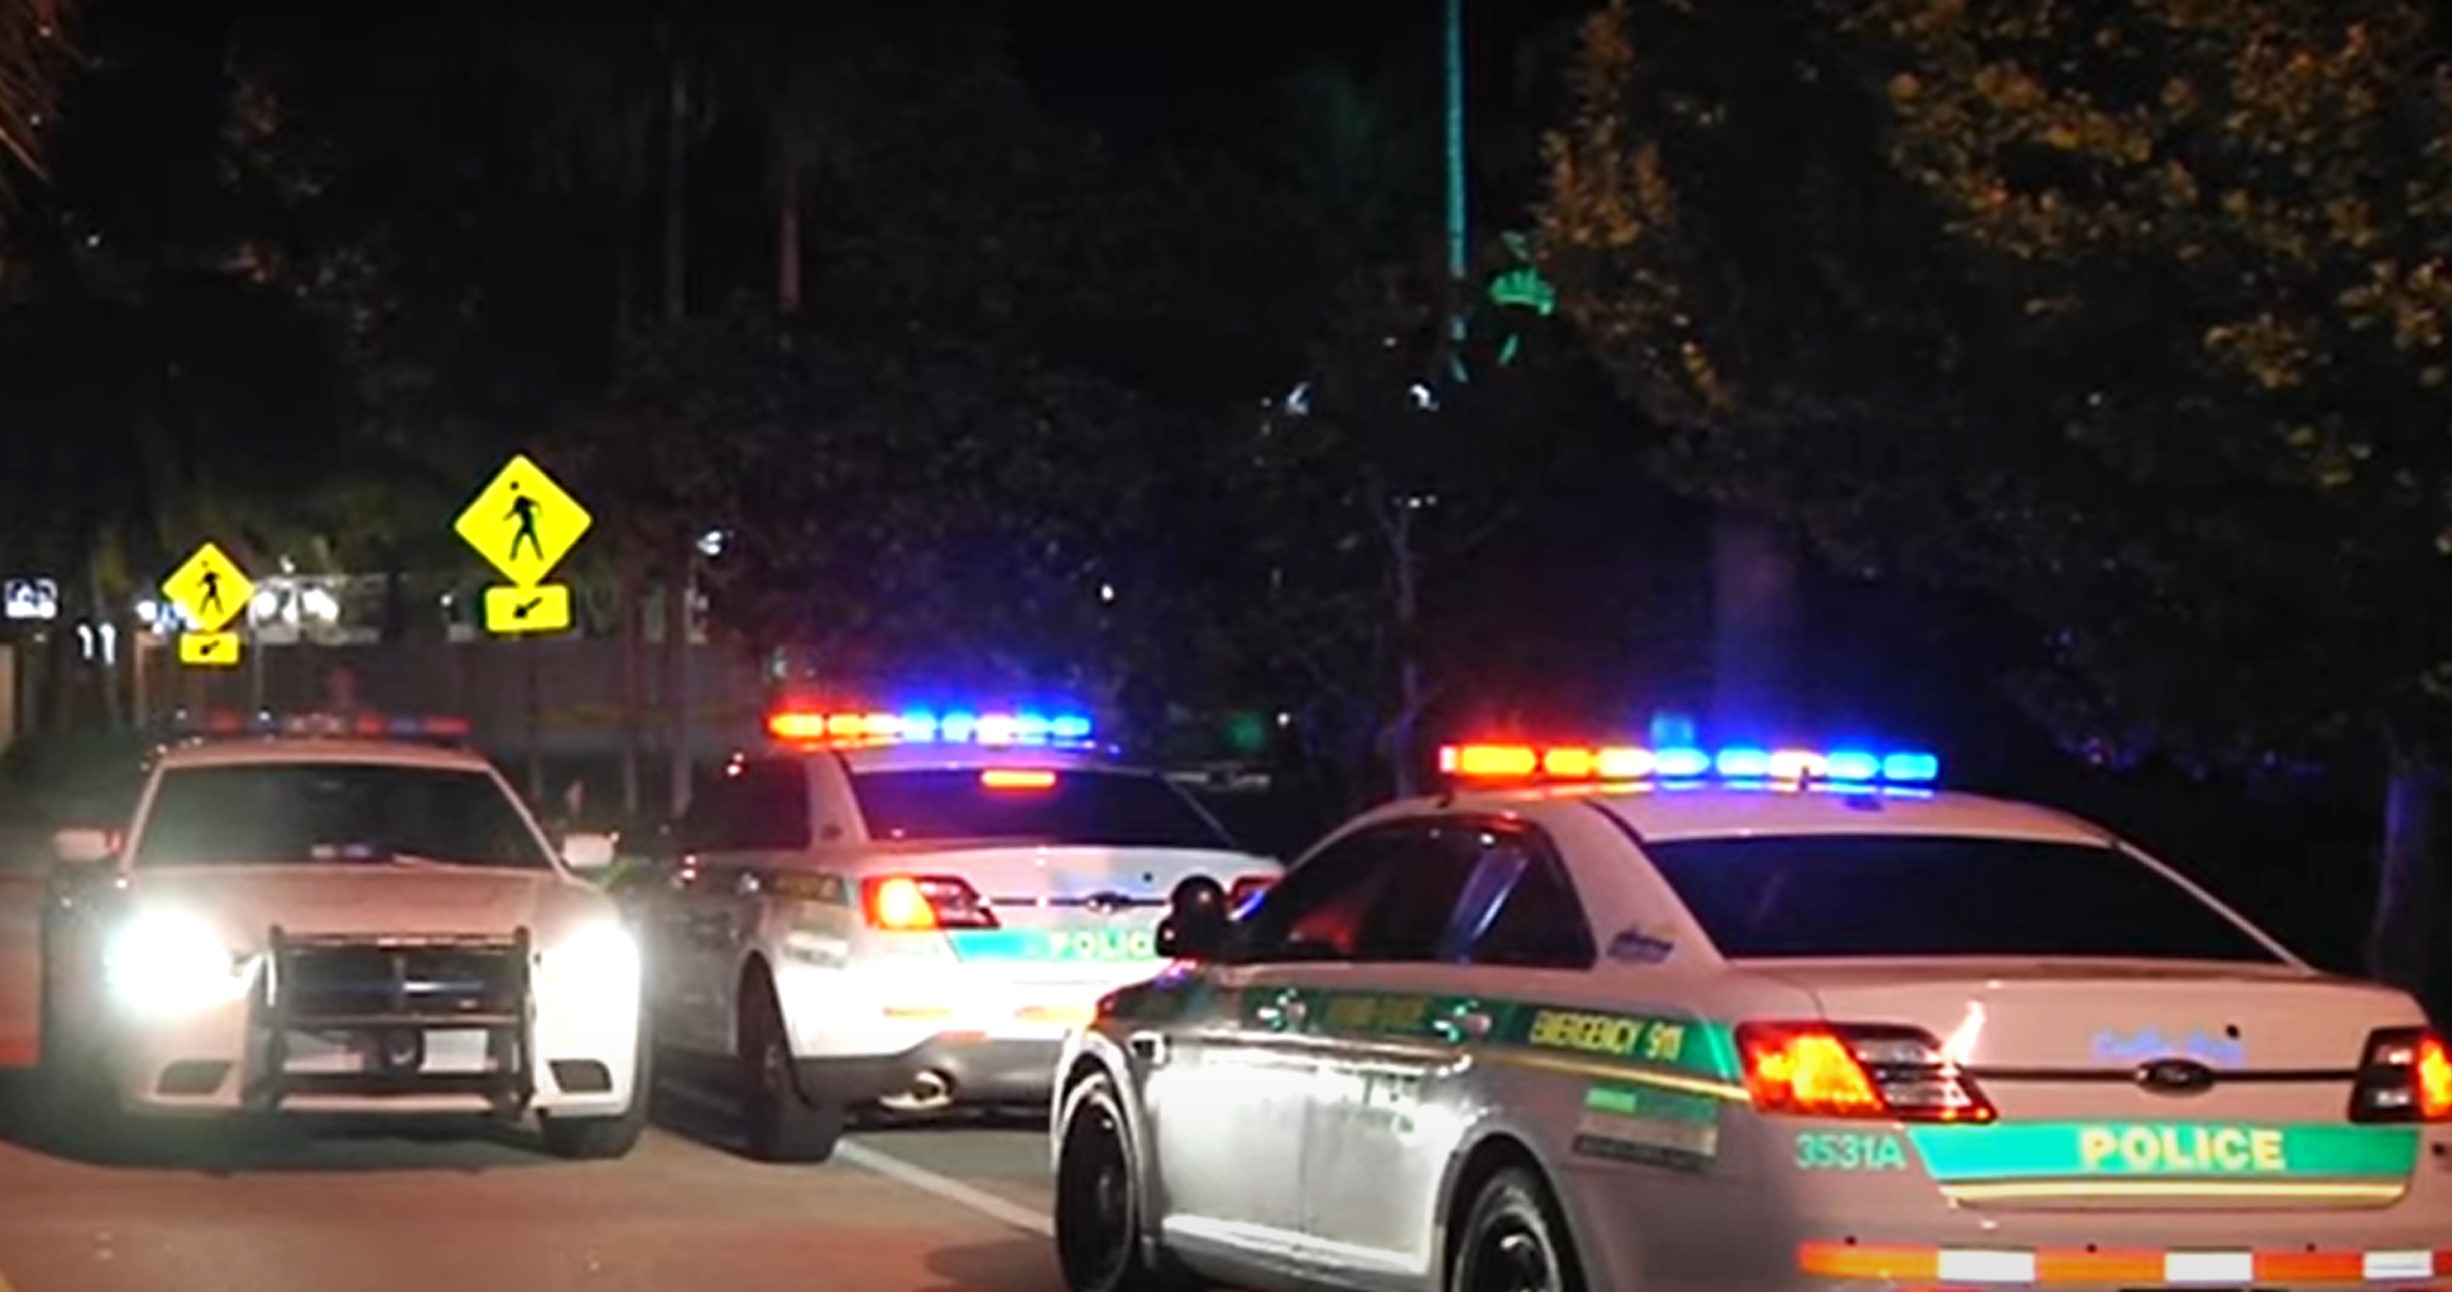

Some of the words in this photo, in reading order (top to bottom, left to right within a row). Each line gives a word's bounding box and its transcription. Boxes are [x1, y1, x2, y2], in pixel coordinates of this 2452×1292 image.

[1049, 928, 1157, 960] POLIC
[1530, 1010, 1643, 1054] EMERGENCY
[1646, 1021, 1685, 1061] 911
[1795, 1132, 1908, 1170] 3531A
[2080, 1128, 2285, 1171] POLICE
